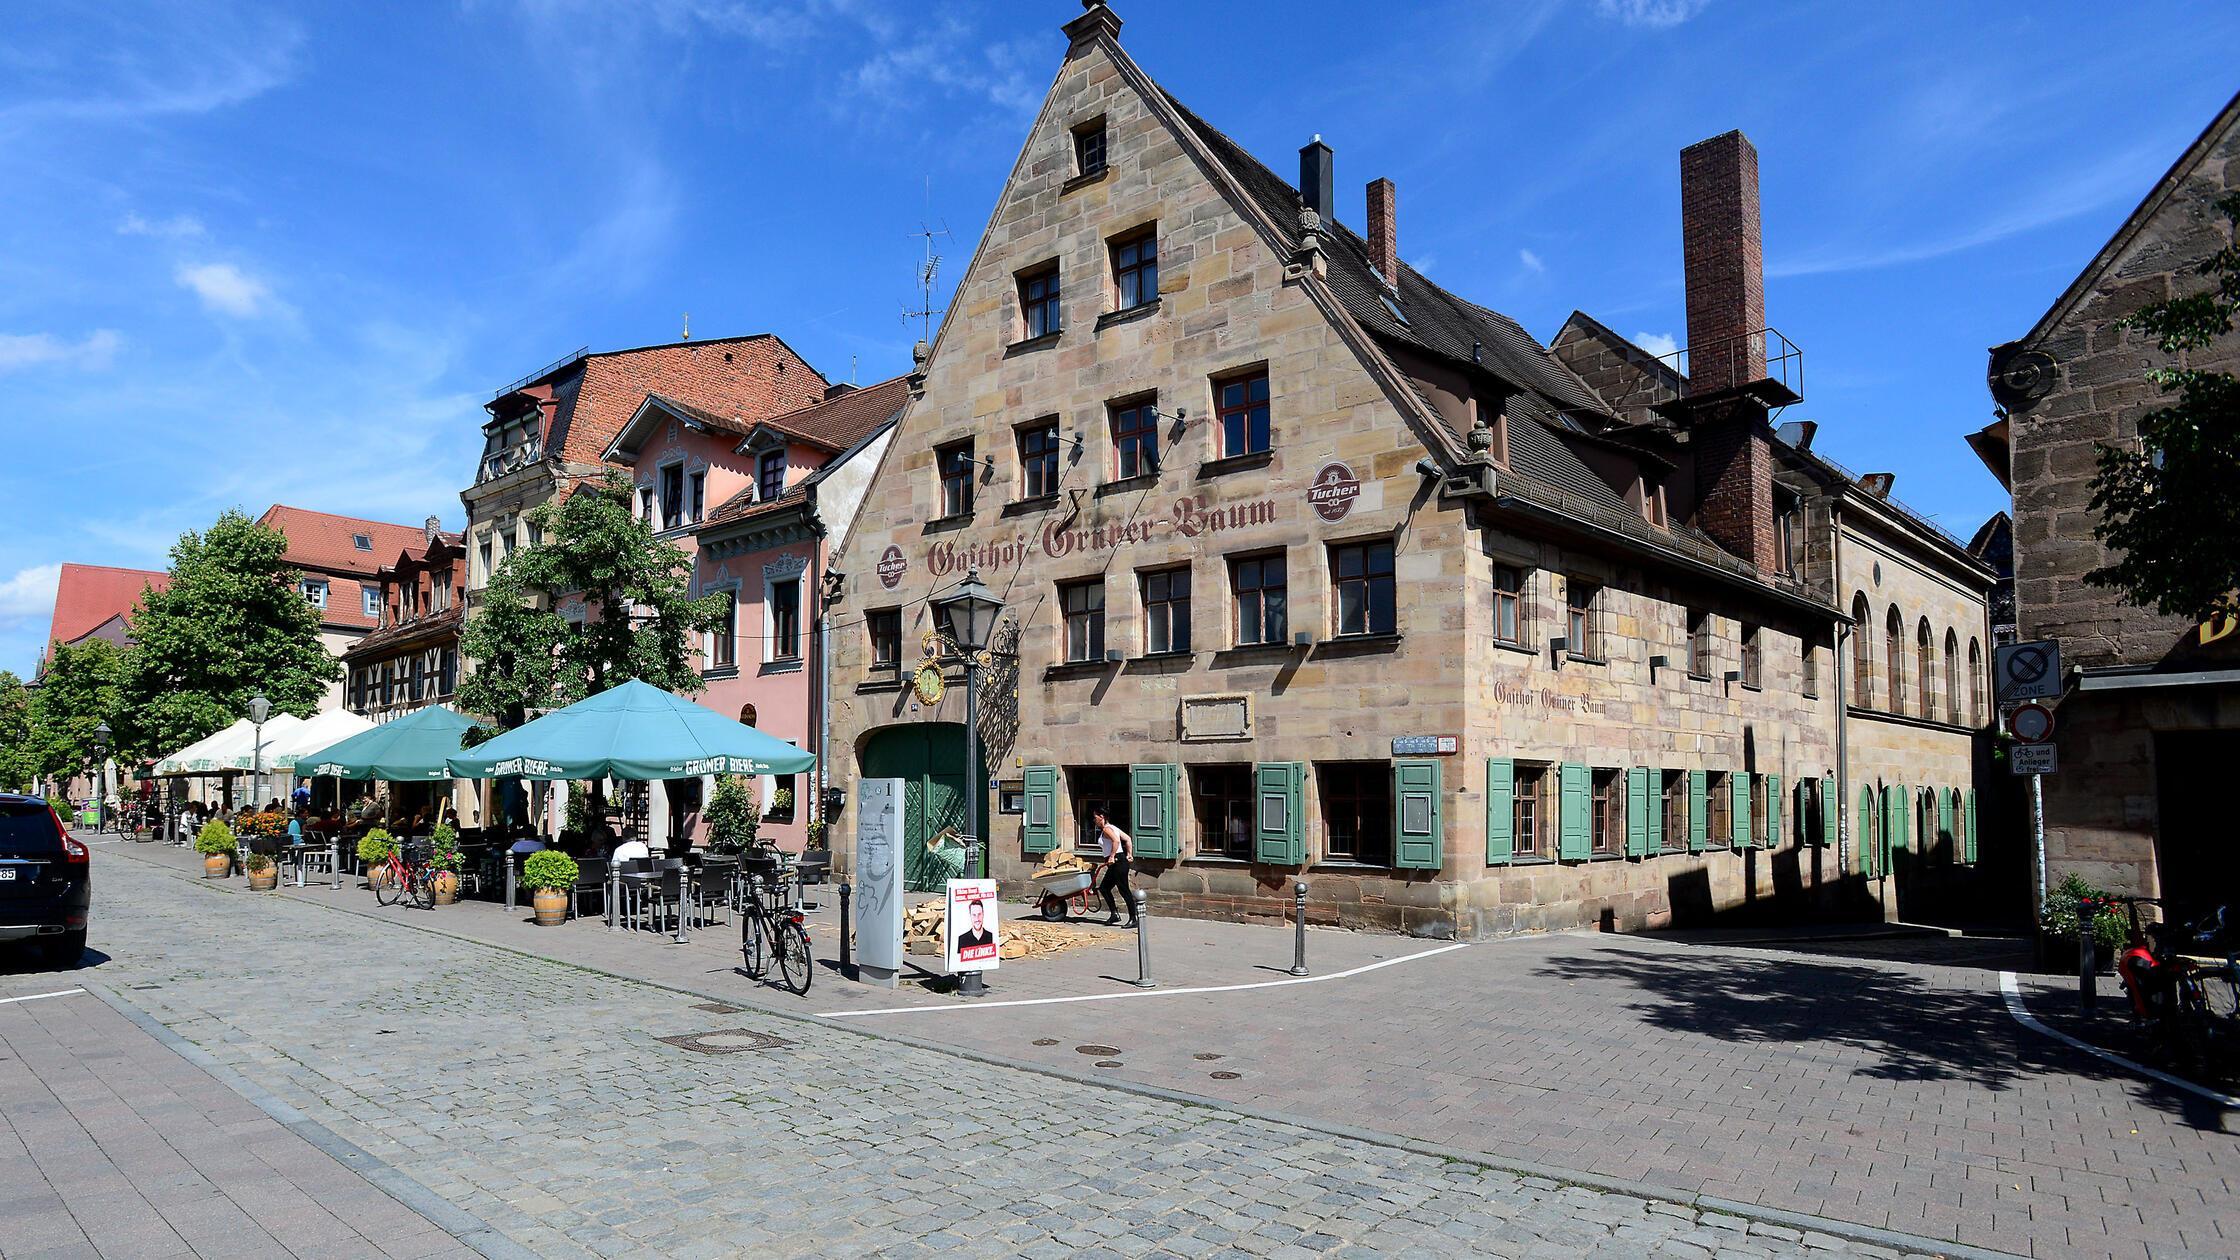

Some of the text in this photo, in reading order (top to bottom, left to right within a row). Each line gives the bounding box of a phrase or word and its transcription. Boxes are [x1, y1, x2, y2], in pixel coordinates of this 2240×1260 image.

[1311, 485, 1358, 500] Tucher
[1172, 495, 1277, 537] Baum
[2014, 685, 2045, 697] ZONE
[2036, 748, 2050, 756] und
[524, 759, 549, 776] BIERE
[729, 757, 755, 773] BIERE
[2019, 758, 2050, 766] Anlieger
[962, 949, 975, 960] DIE
